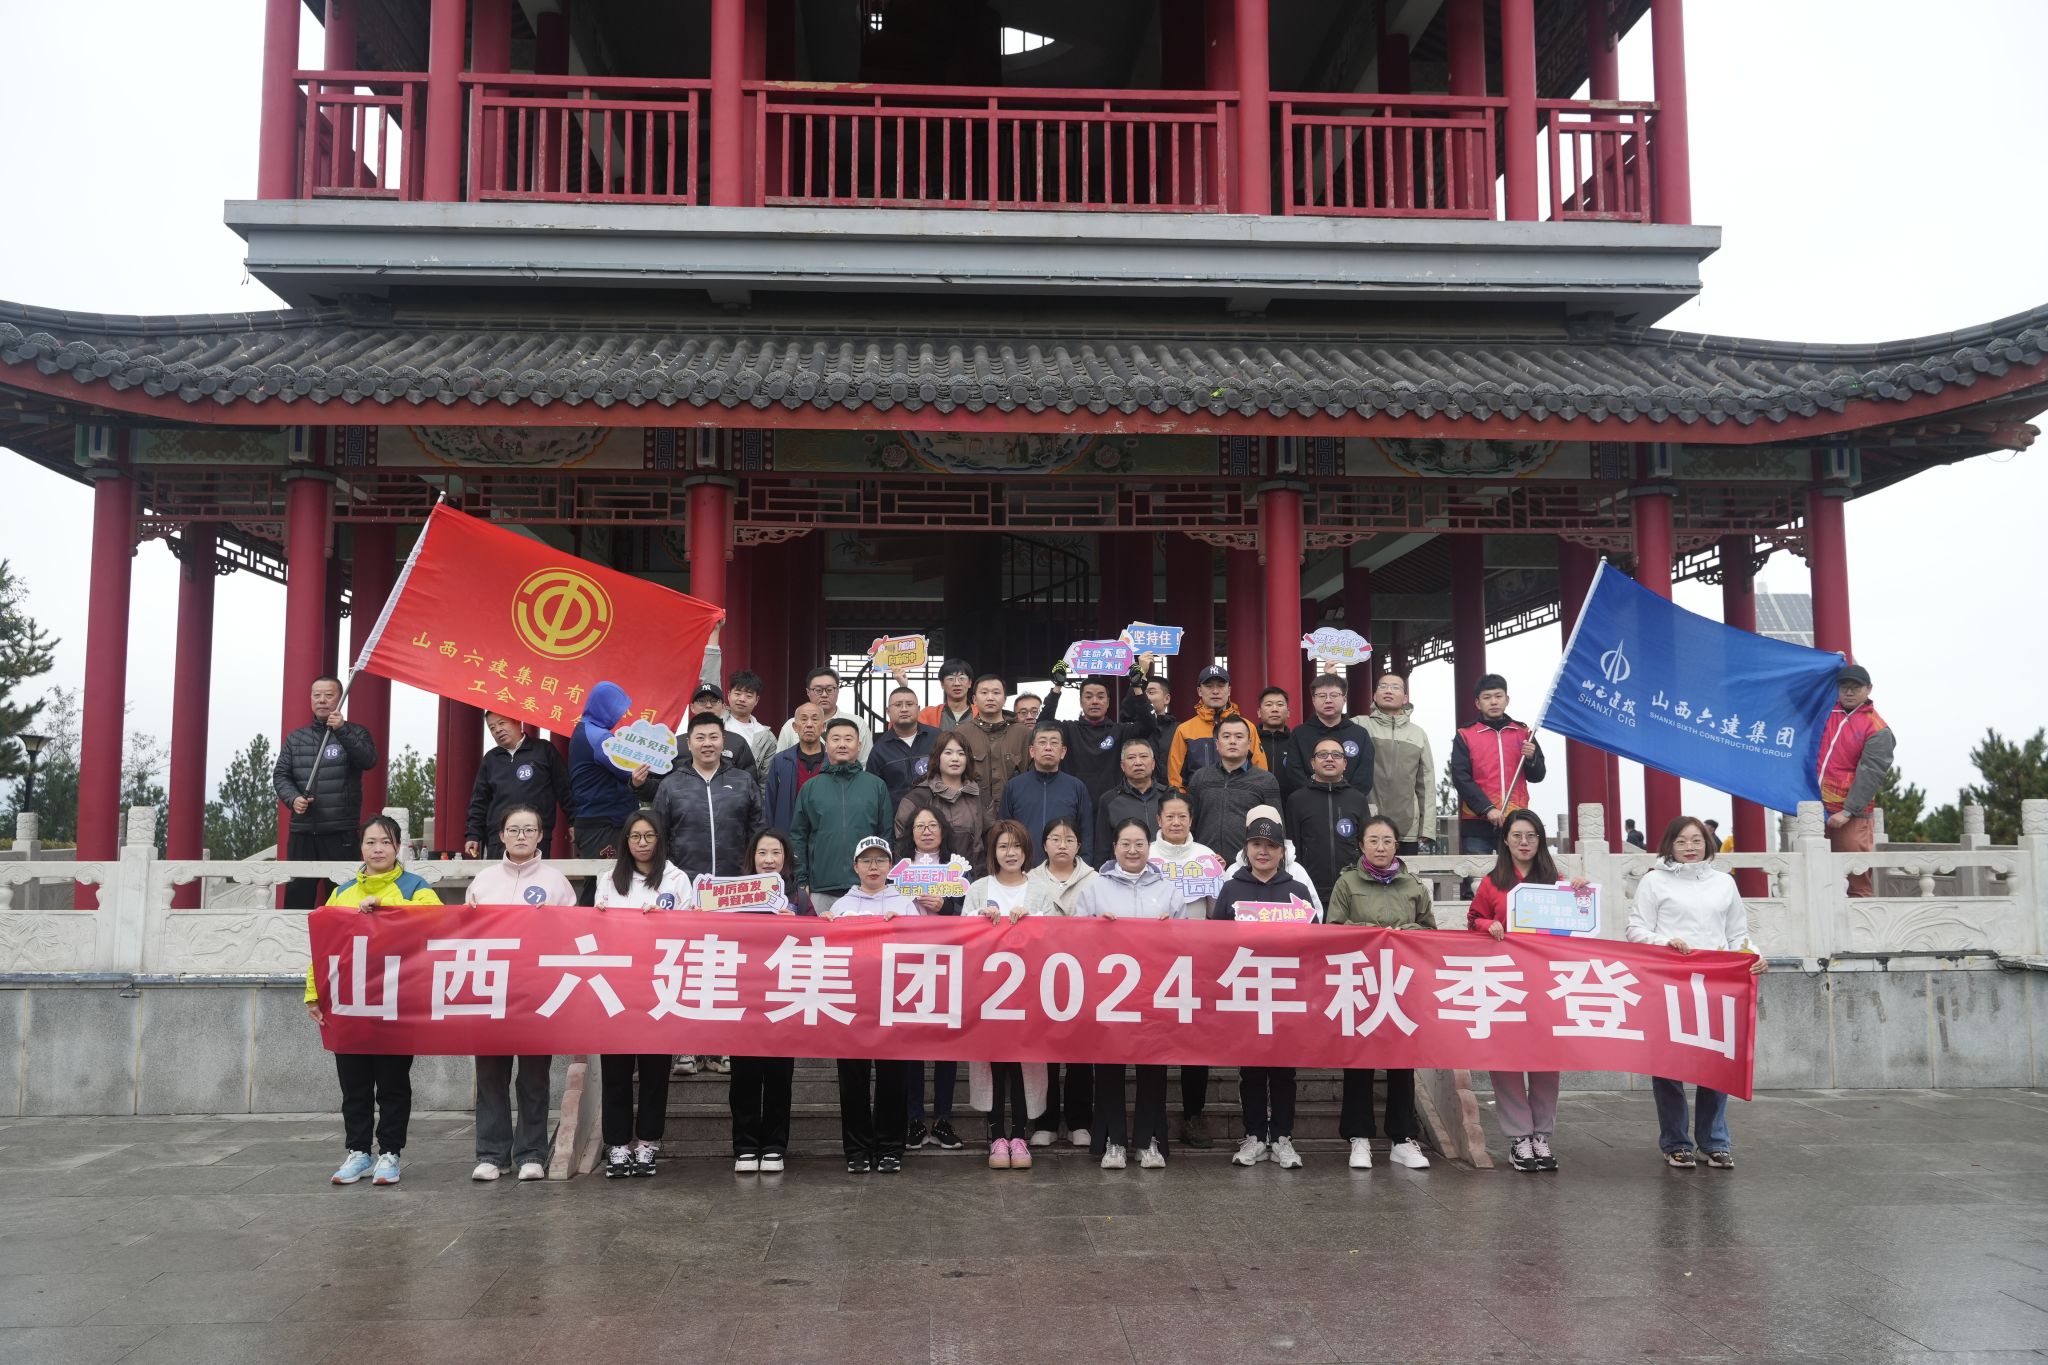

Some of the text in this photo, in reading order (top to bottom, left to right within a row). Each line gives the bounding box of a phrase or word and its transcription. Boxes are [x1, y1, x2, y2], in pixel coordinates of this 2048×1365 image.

[1082, 648, 1127, 658] 生命不息
[1076, 659, 1121, 670] 运动不止
[412, 632, 657, 725] 山西六建集团有司
[1578, 693, 1636, 728] SHANXI CIG
[1651, 690, 1795, 749] 山西六建集团
[624, 733, 670, 755] 山不见我
[1649, 711, 1793, 759] SHANXI SIXTH CONSTRUCTION GROUP
[326, 748, 338, 757] 18
[611, 743, 666, 769] 我自去见山
[1344, 745, 1356, 755] 42
[519, 769, 531, 779] 28
[1340, 824, 1351, 834] 17
[1258, 907, 1307, 921] 全力以赴
[327, 933, 1736, 1061] 山西六建集团2024年秋季登山
